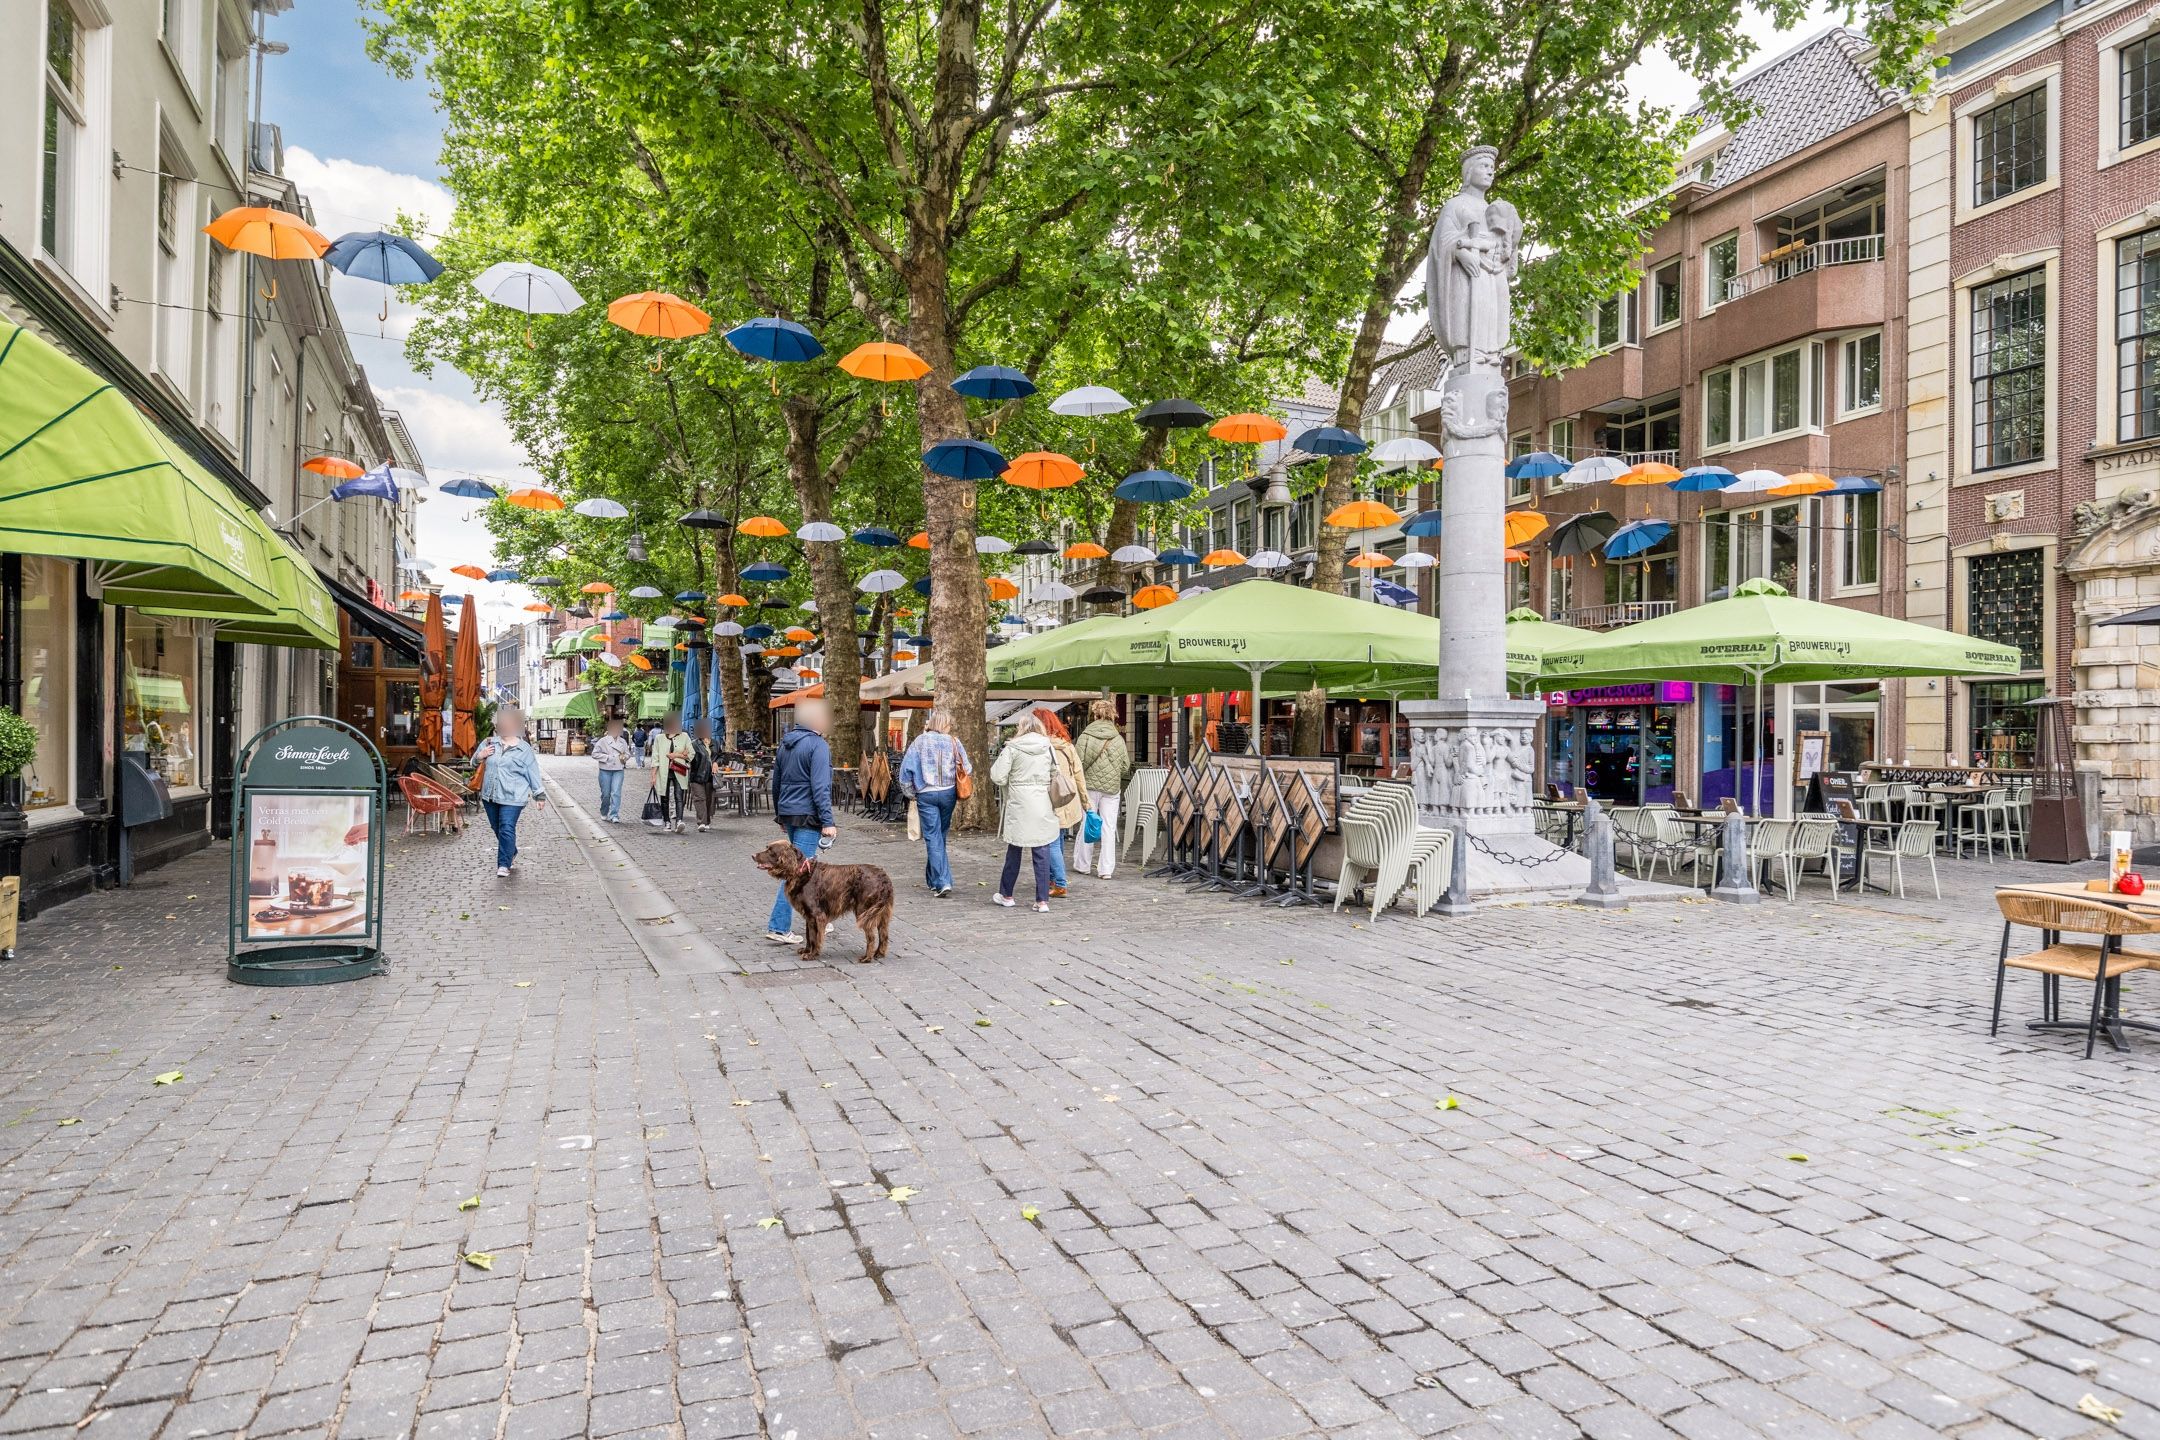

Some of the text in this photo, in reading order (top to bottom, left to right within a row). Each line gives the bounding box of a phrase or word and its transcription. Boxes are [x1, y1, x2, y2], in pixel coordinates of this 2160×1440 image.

[1130, 640, 1162, 650] BOTERHAL
[1179, 638, 1230, 649] BROUWERIJ
[1239, 638, 1247, 649] IJ
[1700, 643, 1767, 654] BOTERHAL
[1789, 640, 1837, 652] BROUWERIJ
[1844, 642, 1851, 653] IJ
[1506, 652, 1538, 662] ERHAL
[1541, 655, 1573, 666] ROUWERIJ
[1965, 651, 2017, 663] BOTERHAL
[1567, 683, 1653, 704] Gamestate
[275, 745, 350, 765] Simon Lévelt
[258, 806, 289, 815] Verras
[291, 807, 310, 815] met
[258, 816, 281, 825] Cold
